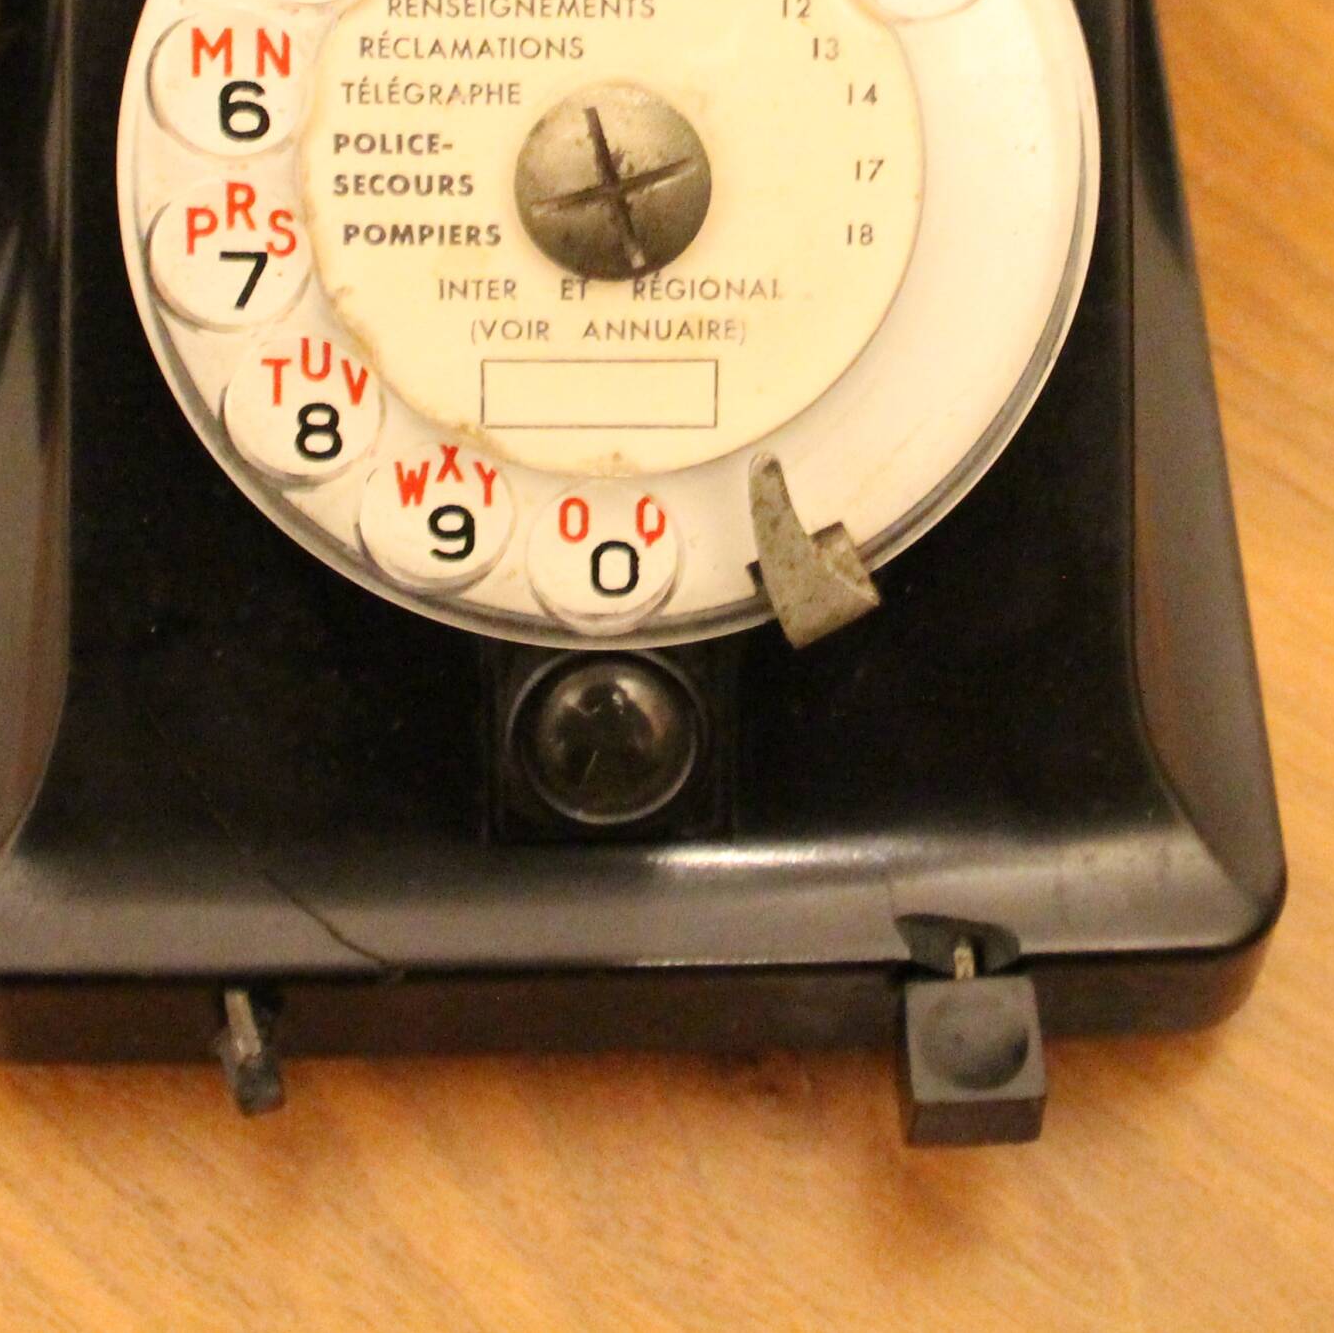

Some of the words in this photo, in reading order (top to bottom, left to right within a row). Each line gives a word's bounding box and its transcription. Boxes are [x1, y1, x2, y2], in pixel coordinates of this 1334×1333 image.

[359, 33, 585, 59] RÉCLAMATIONS
[813, 37, 840, 60] 13
[341, 77, 523, 105] TÉLÉGRAPHE
[847, 82, 879, 106] 14
[218, 80, 271, 141] 6
[332, 133, 455, 156] POLICE-
[855, 160, 885, 181] 17
[332, 174, 475, 196] SECOURS
[342, 223, 503, 247] POMPIERS
[846, 223, 875, 246] 18
[218, 250, 269, 311] 7
[438, 278, 519, 301] INTER
[560, 278, 589, 301] ET
[295, 402, 343, 462] 8
[428, 503, 477, 561] 9
